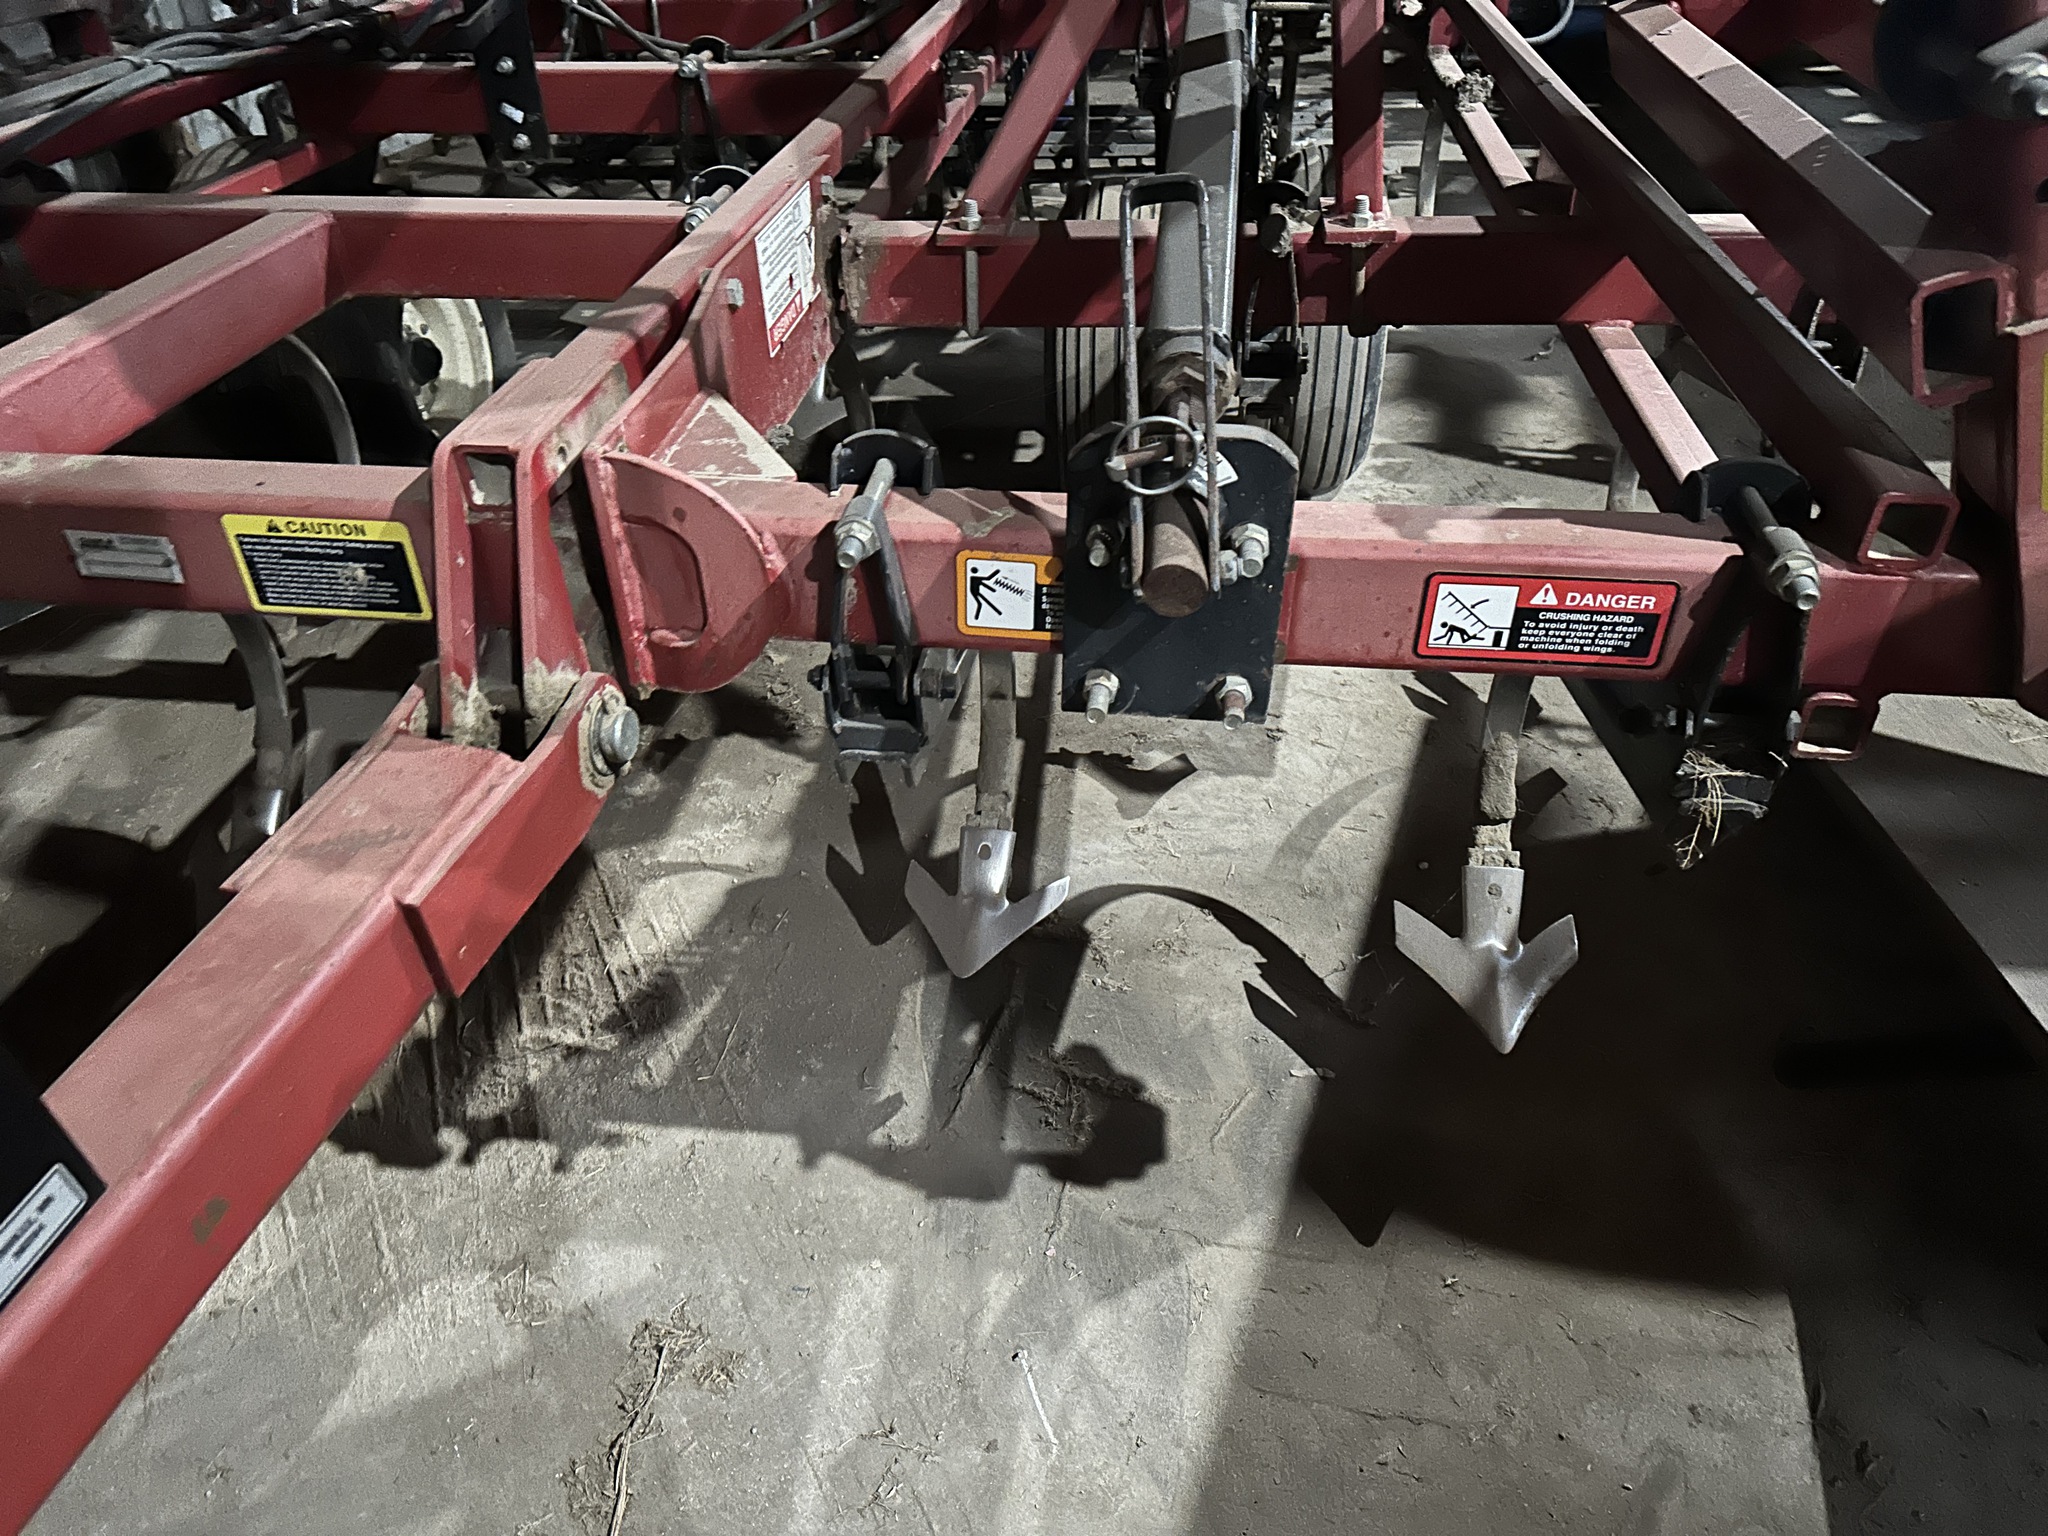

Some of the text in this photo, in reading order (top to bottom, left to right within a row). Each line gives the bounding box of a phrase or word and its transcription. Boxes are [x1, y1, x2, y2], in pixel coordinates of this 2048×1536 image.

[284, 521, 367, 537] CAUTION
[1565, 592, 1656, 609] DANGER
[1538, 612, 1635, 623] CRUSHING HAZARD
[1523, 620, 1536, 628] To
[1538, 621, 1567, 629] avoid
[1569, 622, 1599, 631] injury
[1615, 625, 1645, 633] death
[1521, 628, 1546, 636] keep
[1548, 630, 1595, 638] everyone
[1597, 631, 1622, 639] clear
[1519, 635, 1631, 648] machine when folding
[1532, 642, 1581, 652] unfolding
